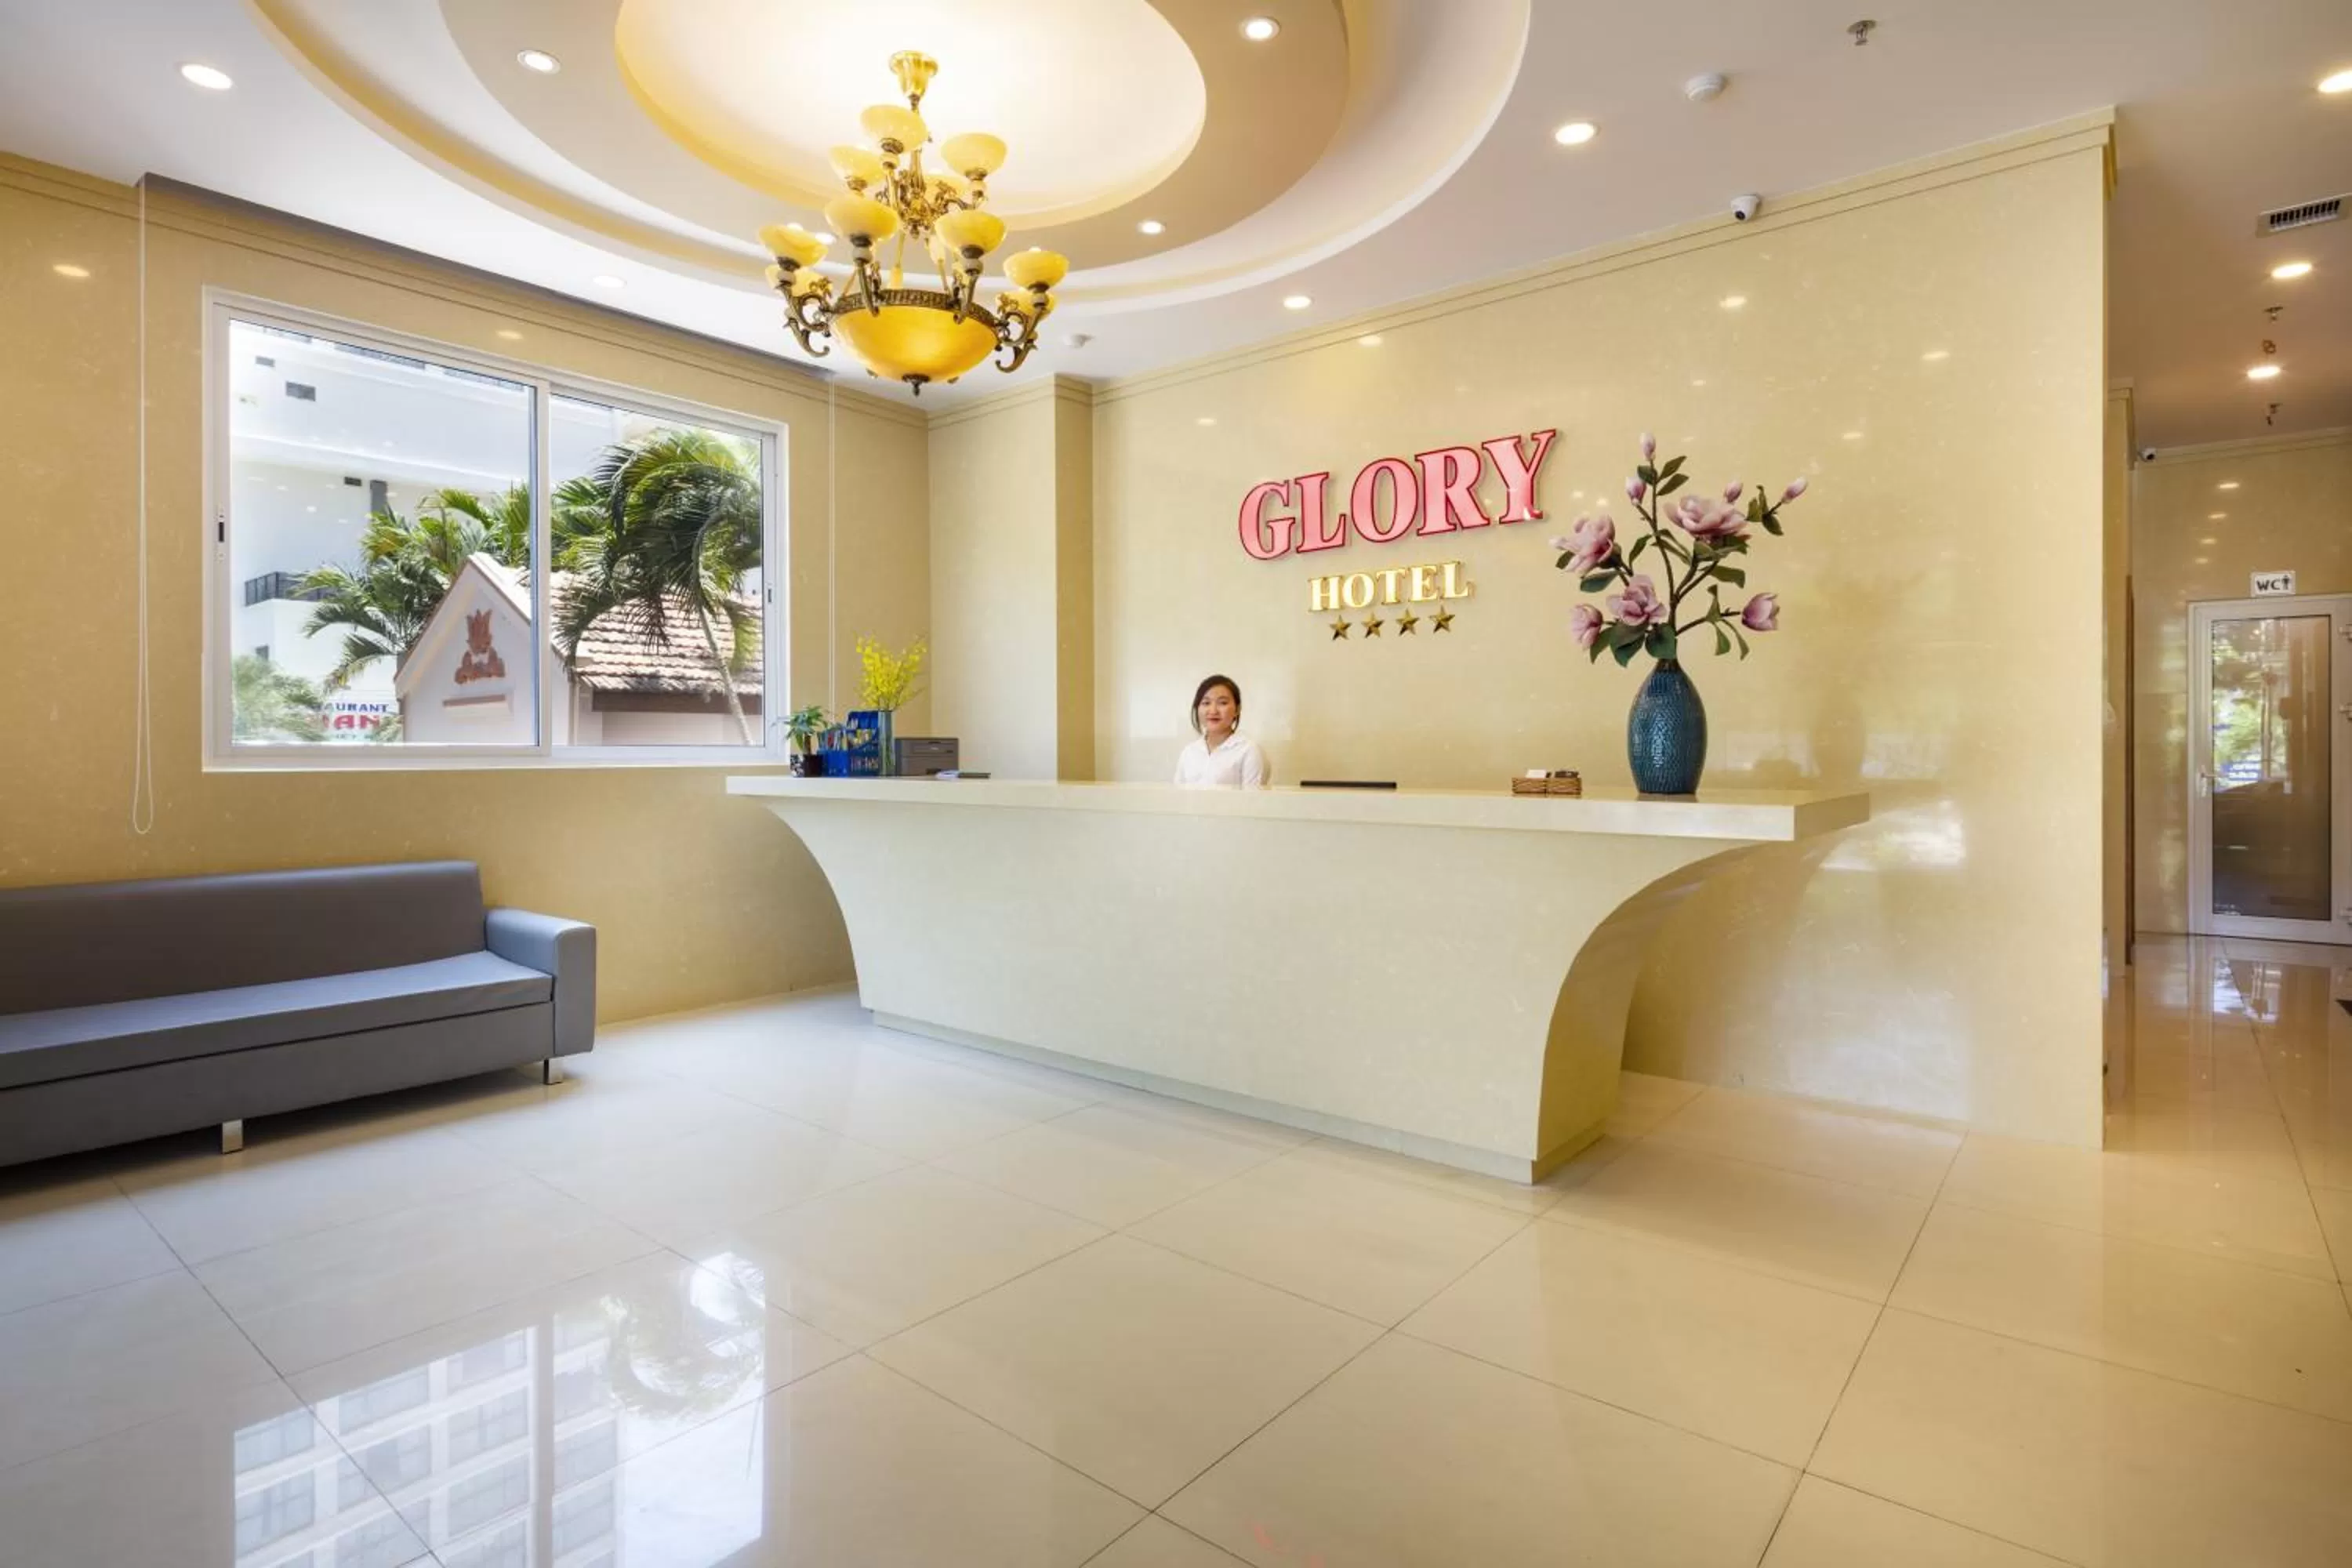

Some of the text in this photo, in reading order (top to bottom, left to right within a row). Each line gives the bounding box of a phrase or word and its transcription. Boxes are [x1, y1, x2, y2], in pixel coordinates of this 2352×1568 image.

[1239, 429, 1558, 560] GLORY
[1308, 561, 1472, 612] HOTEL
[2256, 579, 2281, 591] WC
